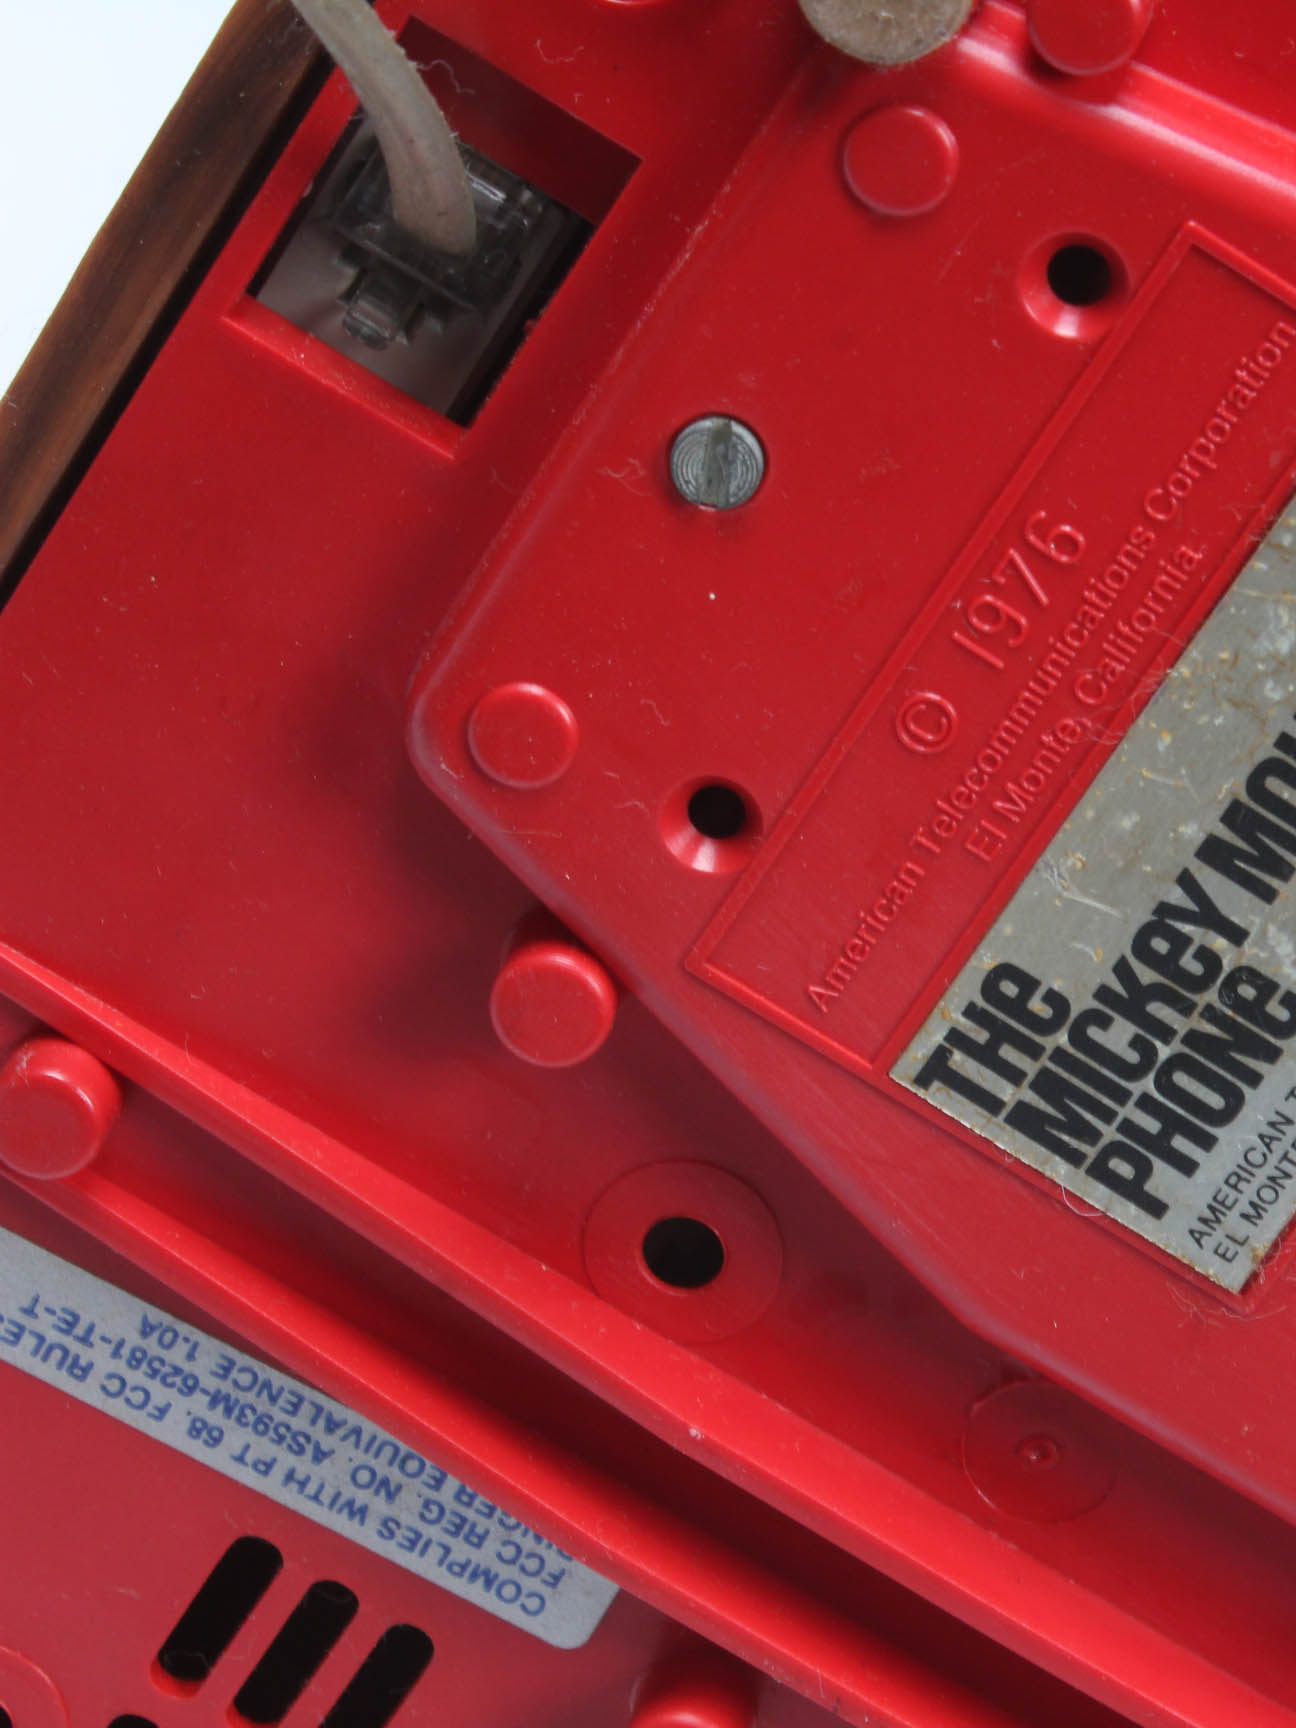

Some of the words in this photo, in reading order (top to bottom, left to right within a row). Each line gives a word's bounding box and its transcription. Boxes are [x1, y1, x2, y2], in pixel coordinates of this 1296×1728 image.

[952, 509, 1089, 671] 1976
[963, 822, 1012, 866] El
[1073, 540, 1204, 707] California
[805, 868, 926, 1014] American
[912, 525, 1155, 862] Telecommunications
[1187, 1110, 1296, 1250] AMERICAN
[1213, 1234, 1250, 1265] EL
[138, 1313, 200, 1362] 1.0A
[18, 1293, 335, 1466] AS593M-62581-TE-T
[99, 1371, 173, 1423] FCC
[208, 1352, 449, 1494] EQUIVALENCE
[230, 1443, 278, 1478] PT
[347, 1457, 403, 1505] NO.
[281, 1466, 369, 1527] WITH
[416, 1493, 491, 1550] REG.
[376, 1516, 547, 1617] COMPLIES
[495, 1538, 567, 1590] FCC
